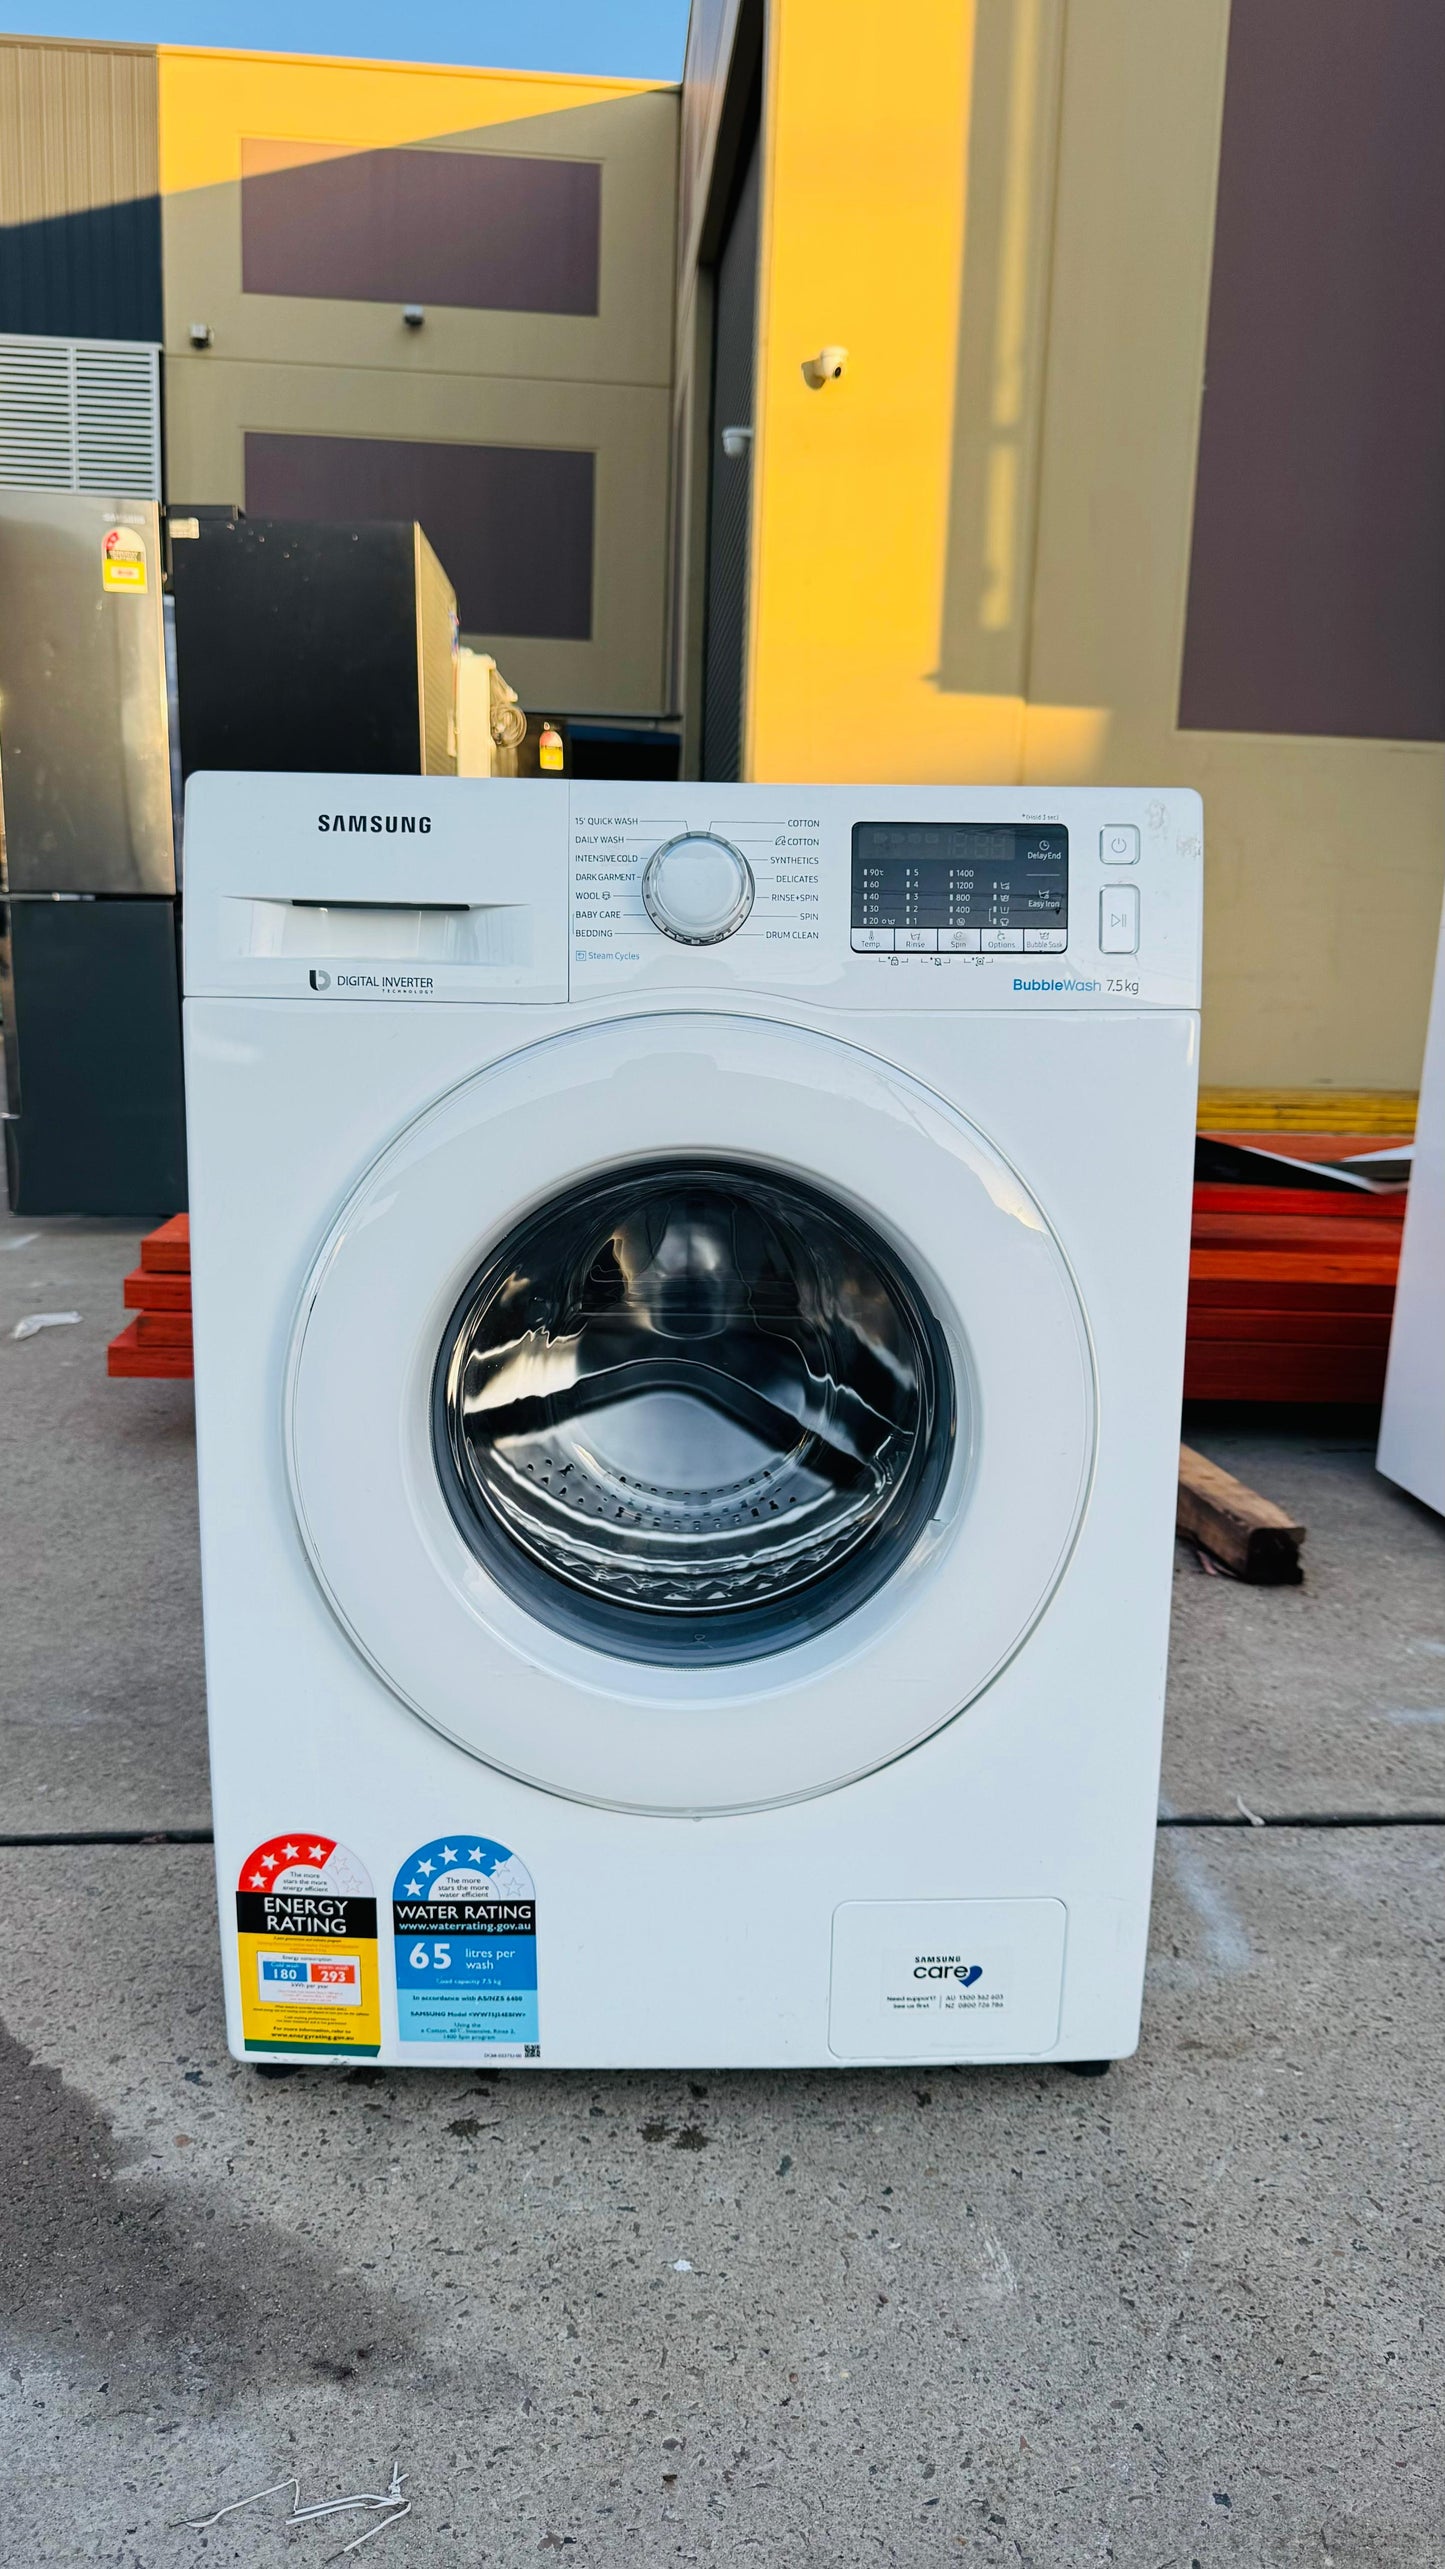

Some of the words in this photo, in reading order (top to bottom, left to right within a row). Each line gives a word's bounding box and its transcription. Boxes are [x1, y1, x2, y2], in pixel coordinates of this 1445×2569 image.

[318, 814, 432, 834] SAMSUNG
[587, 817, 613, 826] QUICK
[614, 817, 639, 825] WASH
[787, 819, 820, 827] COTTON
[575, 836, 599, 844] DAILY
[600, 836, 624, 844] WASH
[787, 838, 820, 846] COTTON
[575, 854, 616, 863] INTENSIVE
[616, 854, 638, 863] COLD
[770, 856, 819, 865] SYNTHETICS
[575, 873, 597, 881] DARK
[598, 873, 636, 881] GARMENT
[956, 869, 974, 877] 1400
[776, 875, 819, 883] DELICATES
[575, 892, 600, 900] WOOL
[771, 894, 819, 902] RINSE+SPIN
[913, 905, 919, 913] 2
[1028, 900, 1044, 909] Easy
[800, 912, 819, 921] SPIN
[869, 917, 879, 925] 20
[913, 917, 918, 925] 1
[575, 929, 613, 937] BEDDING
[766, 931, 790, 939] DRUM
[792, 931, 819, 939] CLEAN
[950, 941, 967, 949] Spin
[988, 941, 1016, 949] Options
[588, 951, 614, 960] Steam
[614, 951, 640, 961] Cycles
[337, 975, 380, 987] DIGITAL
[382, 976, 434, 988] INVERTER
[1013, 978, 1102, 991] BubbleWash
[1106, 979, 1123, 992] 7.5
[1125, 979, 1139, 995] kg
[263, 1897, 348, 1916] ENERGY
[396, 1904, 459, 1919] WATER
[464, 1905, 532, 1919] RATING
[266, 1915, 347, 1934] RATING
[399, 1921, 531, 1933] www.waterrating.gov.au
[409, 1942, 452, 1970] 65
[465, 1948, 493, 1958] litres
[496, 1950, 516, 1961] per
[914, 1955, 961, 1963] SAMSUNG
[465, 1960, 494, 1970] wash
[273, 1968, 298, 1980] 180
[320, 1970, 346, 1982] 293
[913, 1965, 968, 1979] care
